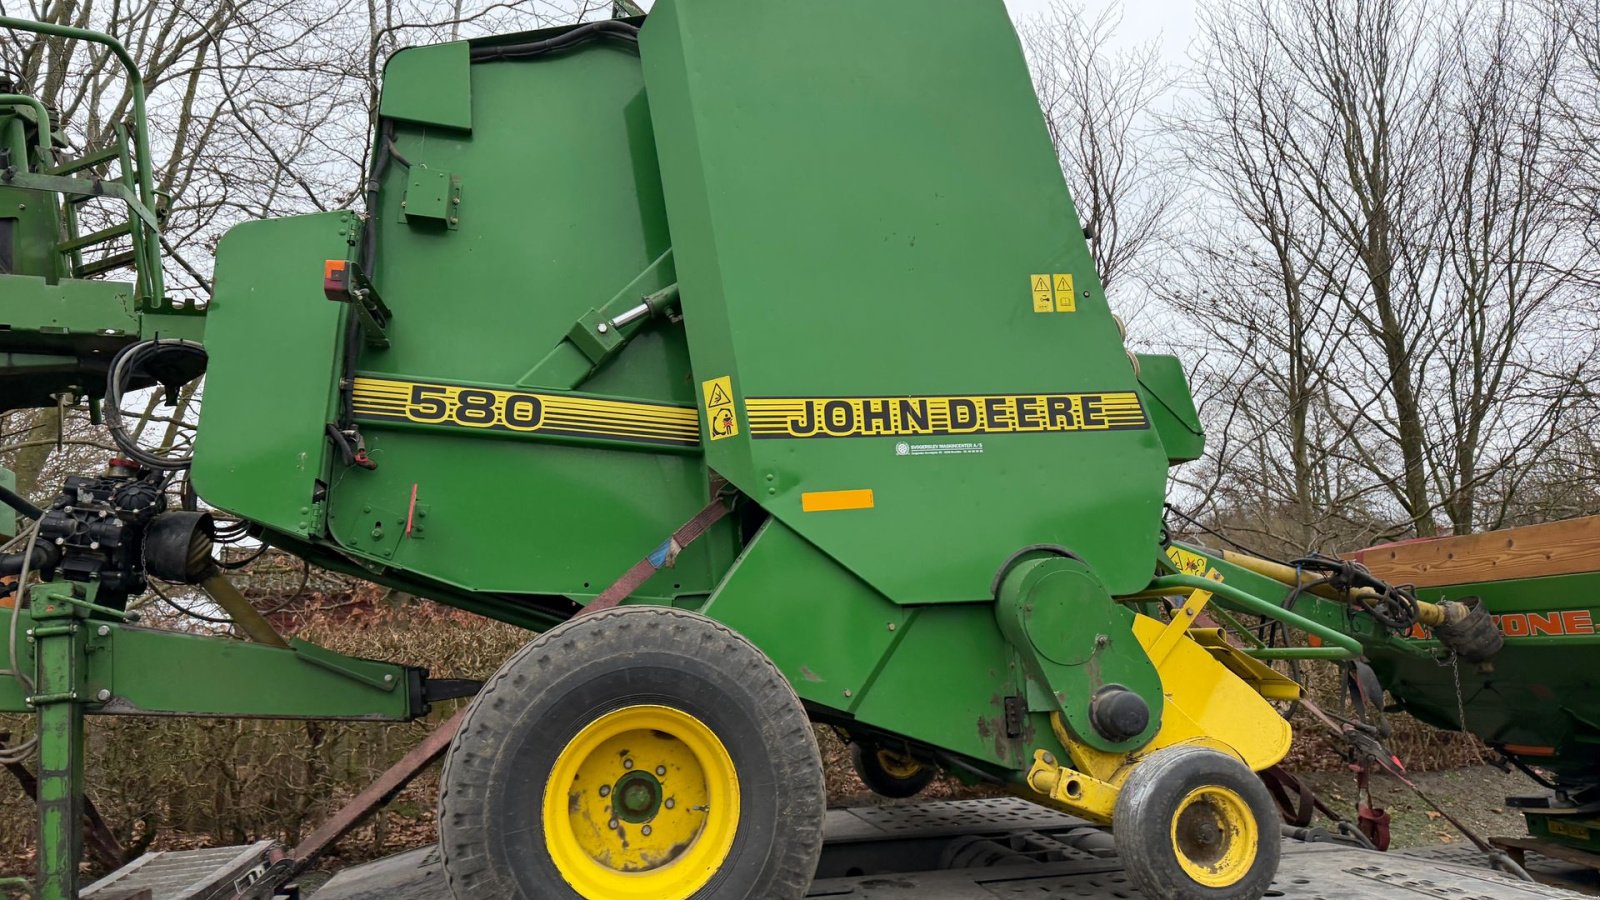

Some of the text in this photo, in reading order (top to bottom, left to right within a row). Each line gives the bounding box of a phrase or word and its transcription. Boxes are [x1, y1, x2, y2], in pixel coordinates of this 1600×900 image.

[405, 385, 546, 431] 580
[787, 394, 1110, 437] JOHN DEERE
